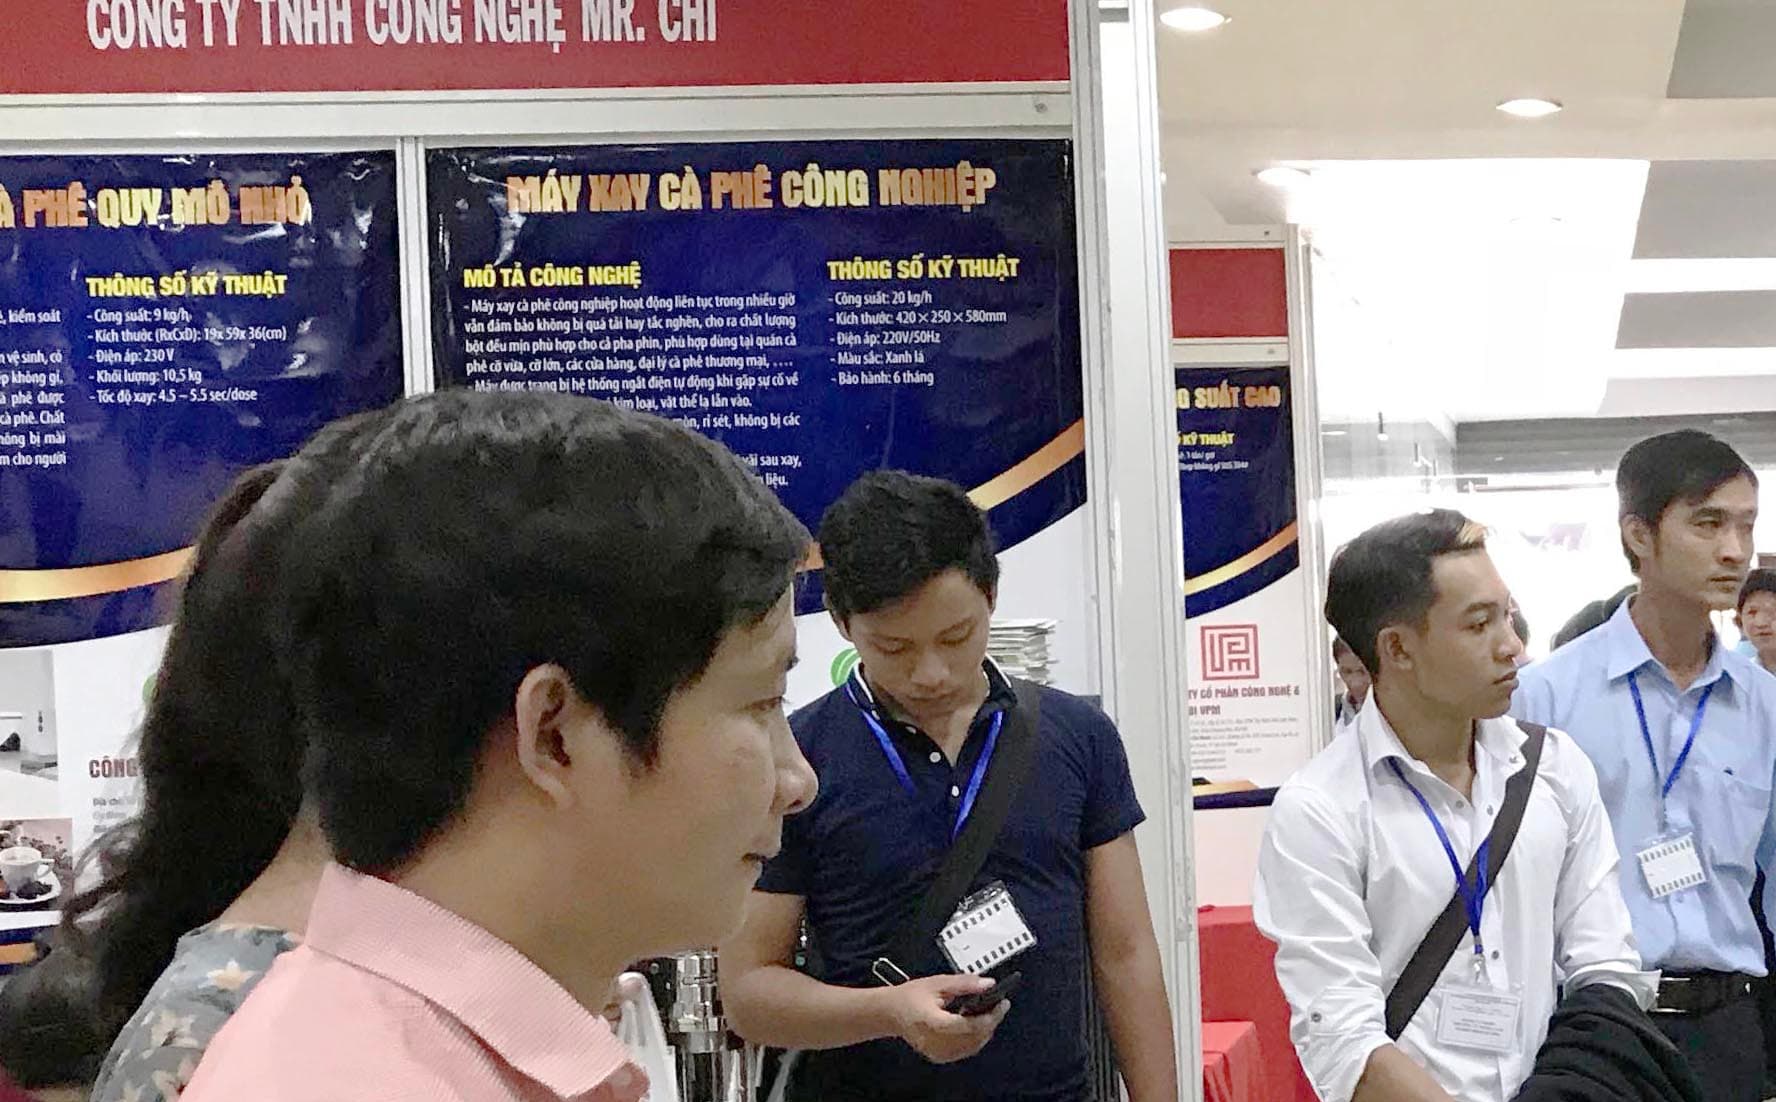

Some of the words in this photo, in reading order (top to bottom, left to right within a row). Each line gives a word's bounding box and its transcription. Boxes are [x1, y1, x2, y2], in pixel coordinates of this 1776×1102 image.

[196, 0, 240, 46] TY
[255, 0, 353, 46] TNHH
[582, 0, 645, 42] MR.
[507, 168, 581, 213] MÁY
[588, 173, 650, 212] XAY
[659, 165, 702, 211] CÀ
[710, 163, 773, 209] PHÊ
[781, 162, 870, 209] CÔNG
[878, 160, 998, 213] NGHIỆP
[23, 181, 88, 228] PHÊ
[97, 187, 162, 228] QUY
[171, 179, 230, 225] MÔ
[464, 263, 496, 288] MÔ
[500, 261, 526, 288] TẢ
[530, 263, 583, 288] CÔNG
[588, 260, 641, 289] NGHỆ
[827, 256, 892, 280] THÔNG
[897, 253, 924, 279] SỐ
[928, 255, 954, 278] KỸ
[957, 254, 1019, 281] THUẬT
[86, 272, 156, 297] THÔNG
[159, 270, 187, 296] SỐ
[191, 271, 218, 295] KỸ
[223, 271, 288, 298] THUẬT
[835, 292, 862, 307] Công
[864, 291, 890, 305] suất:
[892, 291, 905, 304] 20
[907, 290, 932, 306] kg/h
